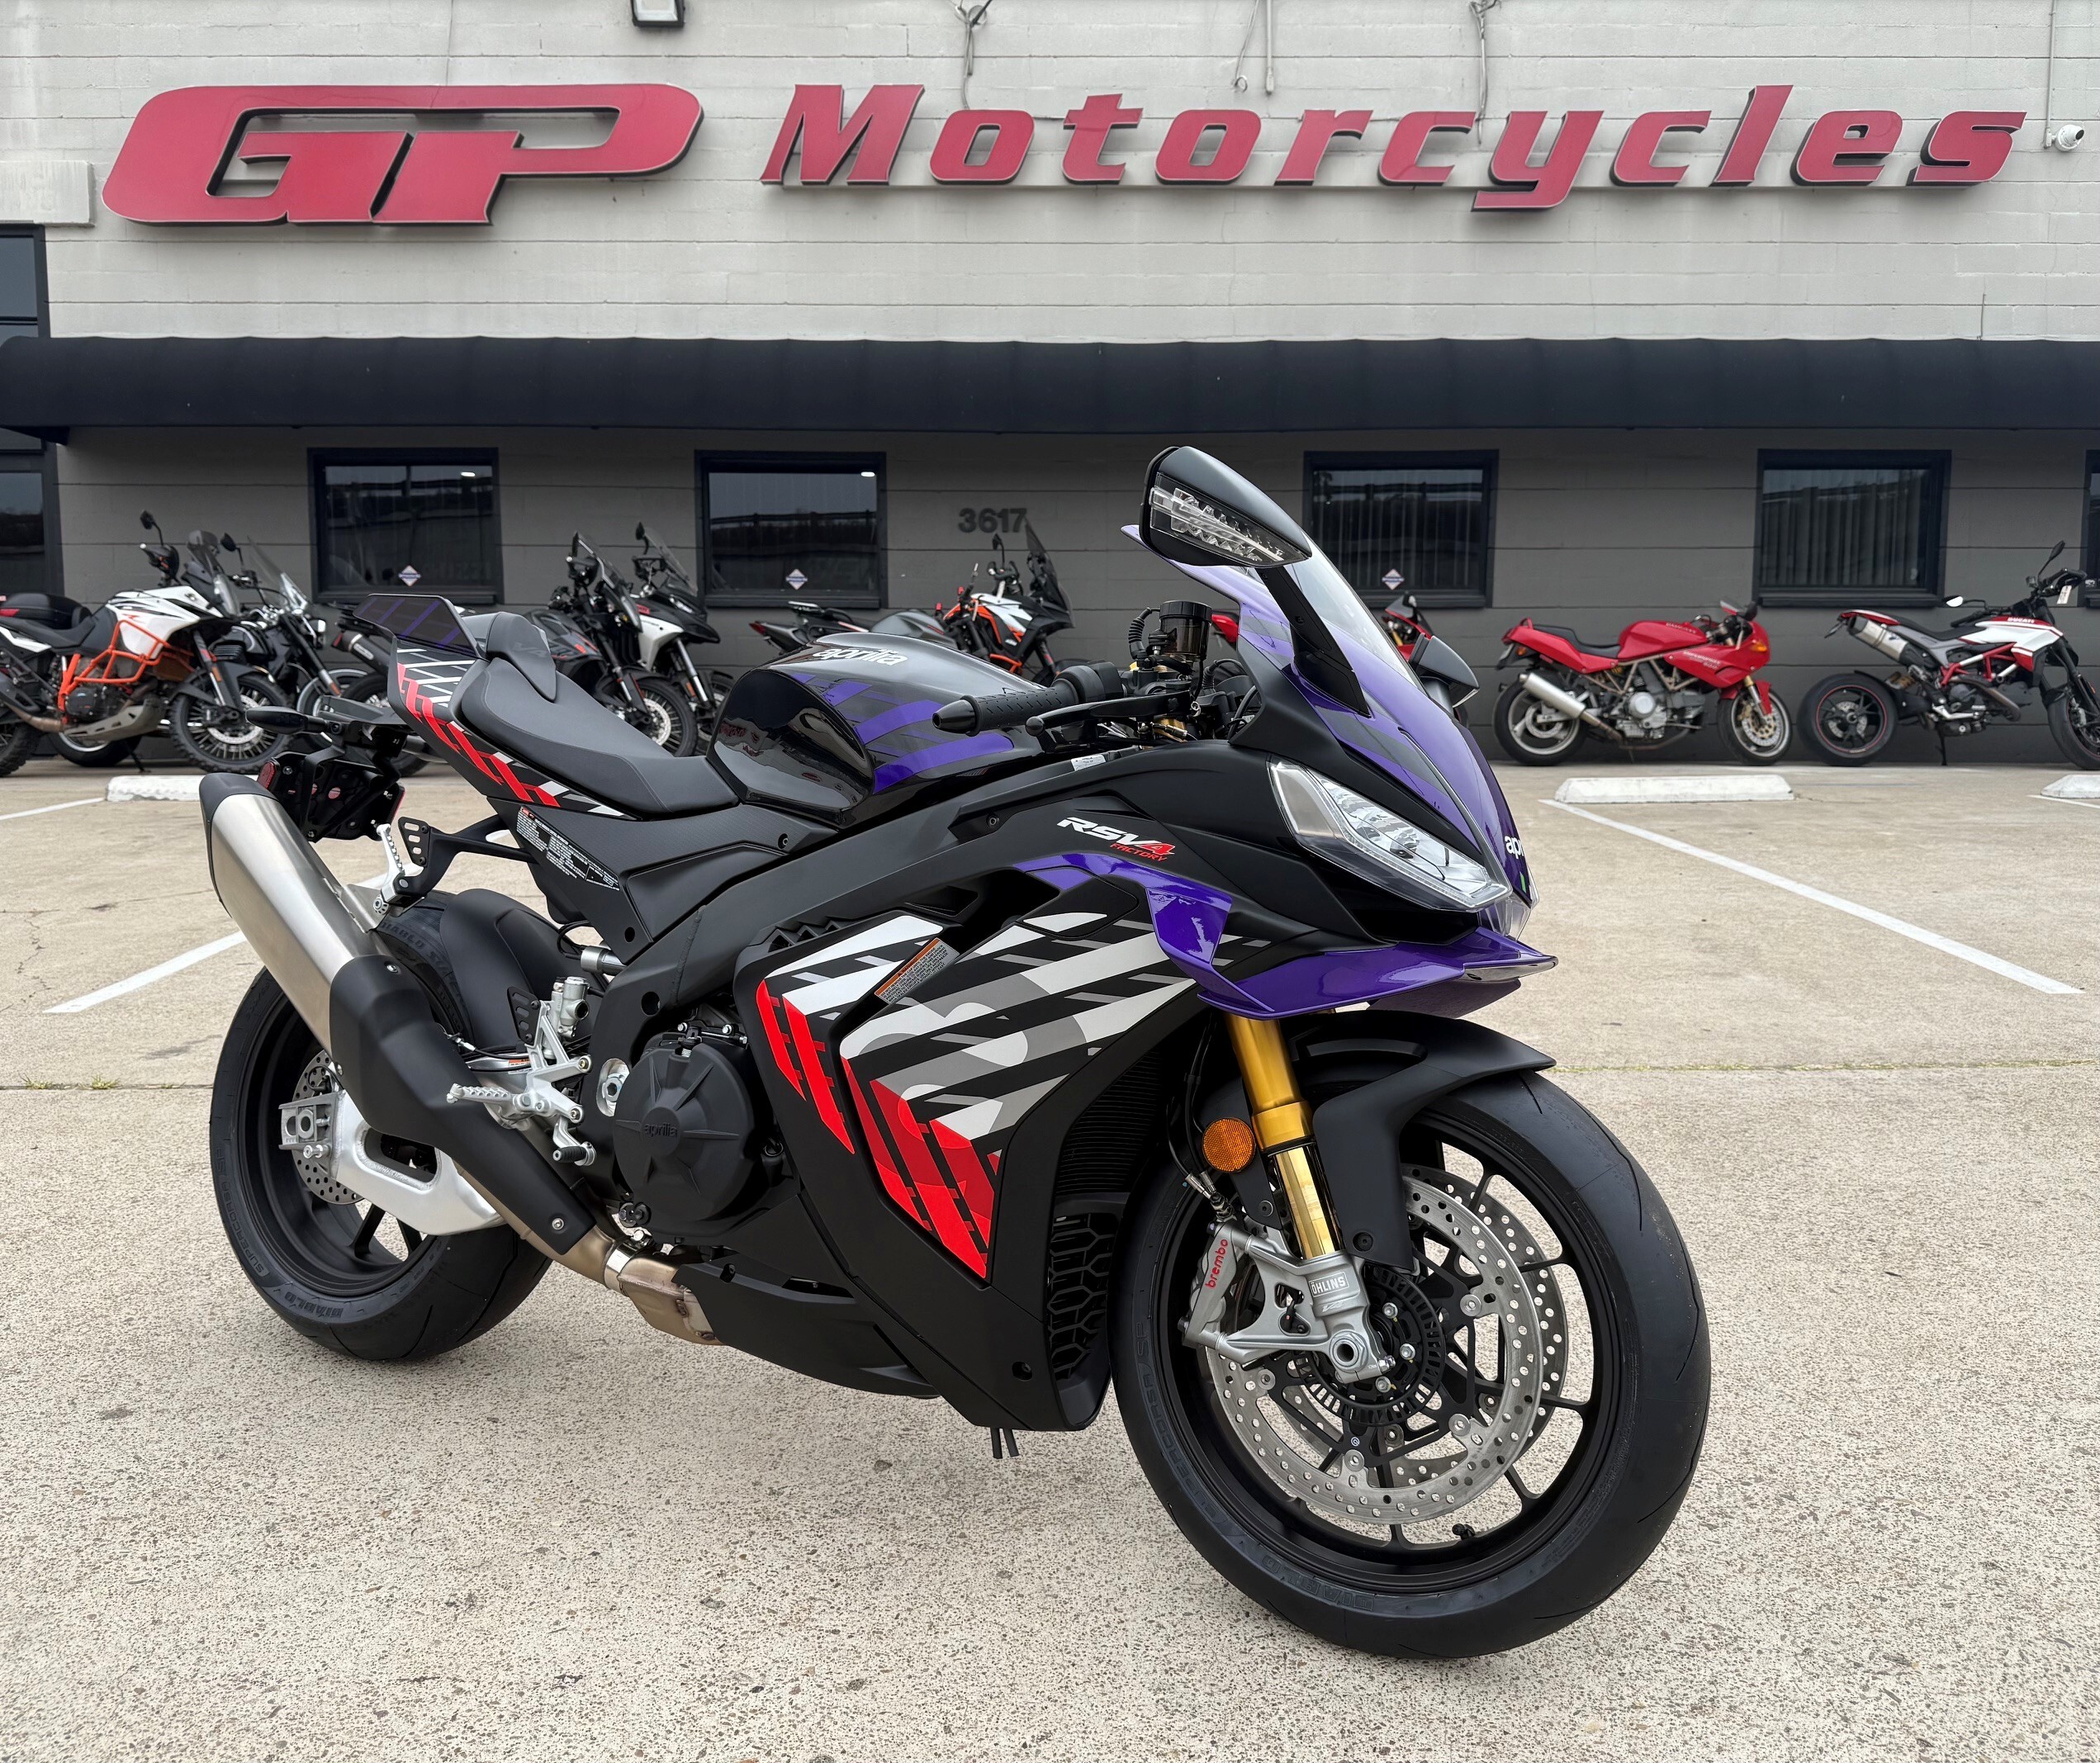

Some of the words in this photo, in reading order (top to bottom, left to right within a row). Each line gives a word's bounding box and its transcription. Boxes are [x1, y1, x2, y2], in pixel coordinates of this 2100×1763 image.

[102, 83, 704, 226] GP
[758, 84, 2027, 212] Motorcycles
[958, 507, 1027, 533] 3617
[813, 648, 908, 666] aprilia
[1056, 817, 1176, 855] RSV4
[1109, 842, 1169, 862] FACTORY
[644, 1122, 678, 1139] aprilia
[1204, 1238, 1229, 1290] brembo
[1311, 1274, 1346, 1295] ÖHLINS
[284, 1291, 344, 1319] DIABLO
[1261, 1554, 1375, 1611] DIABLO
